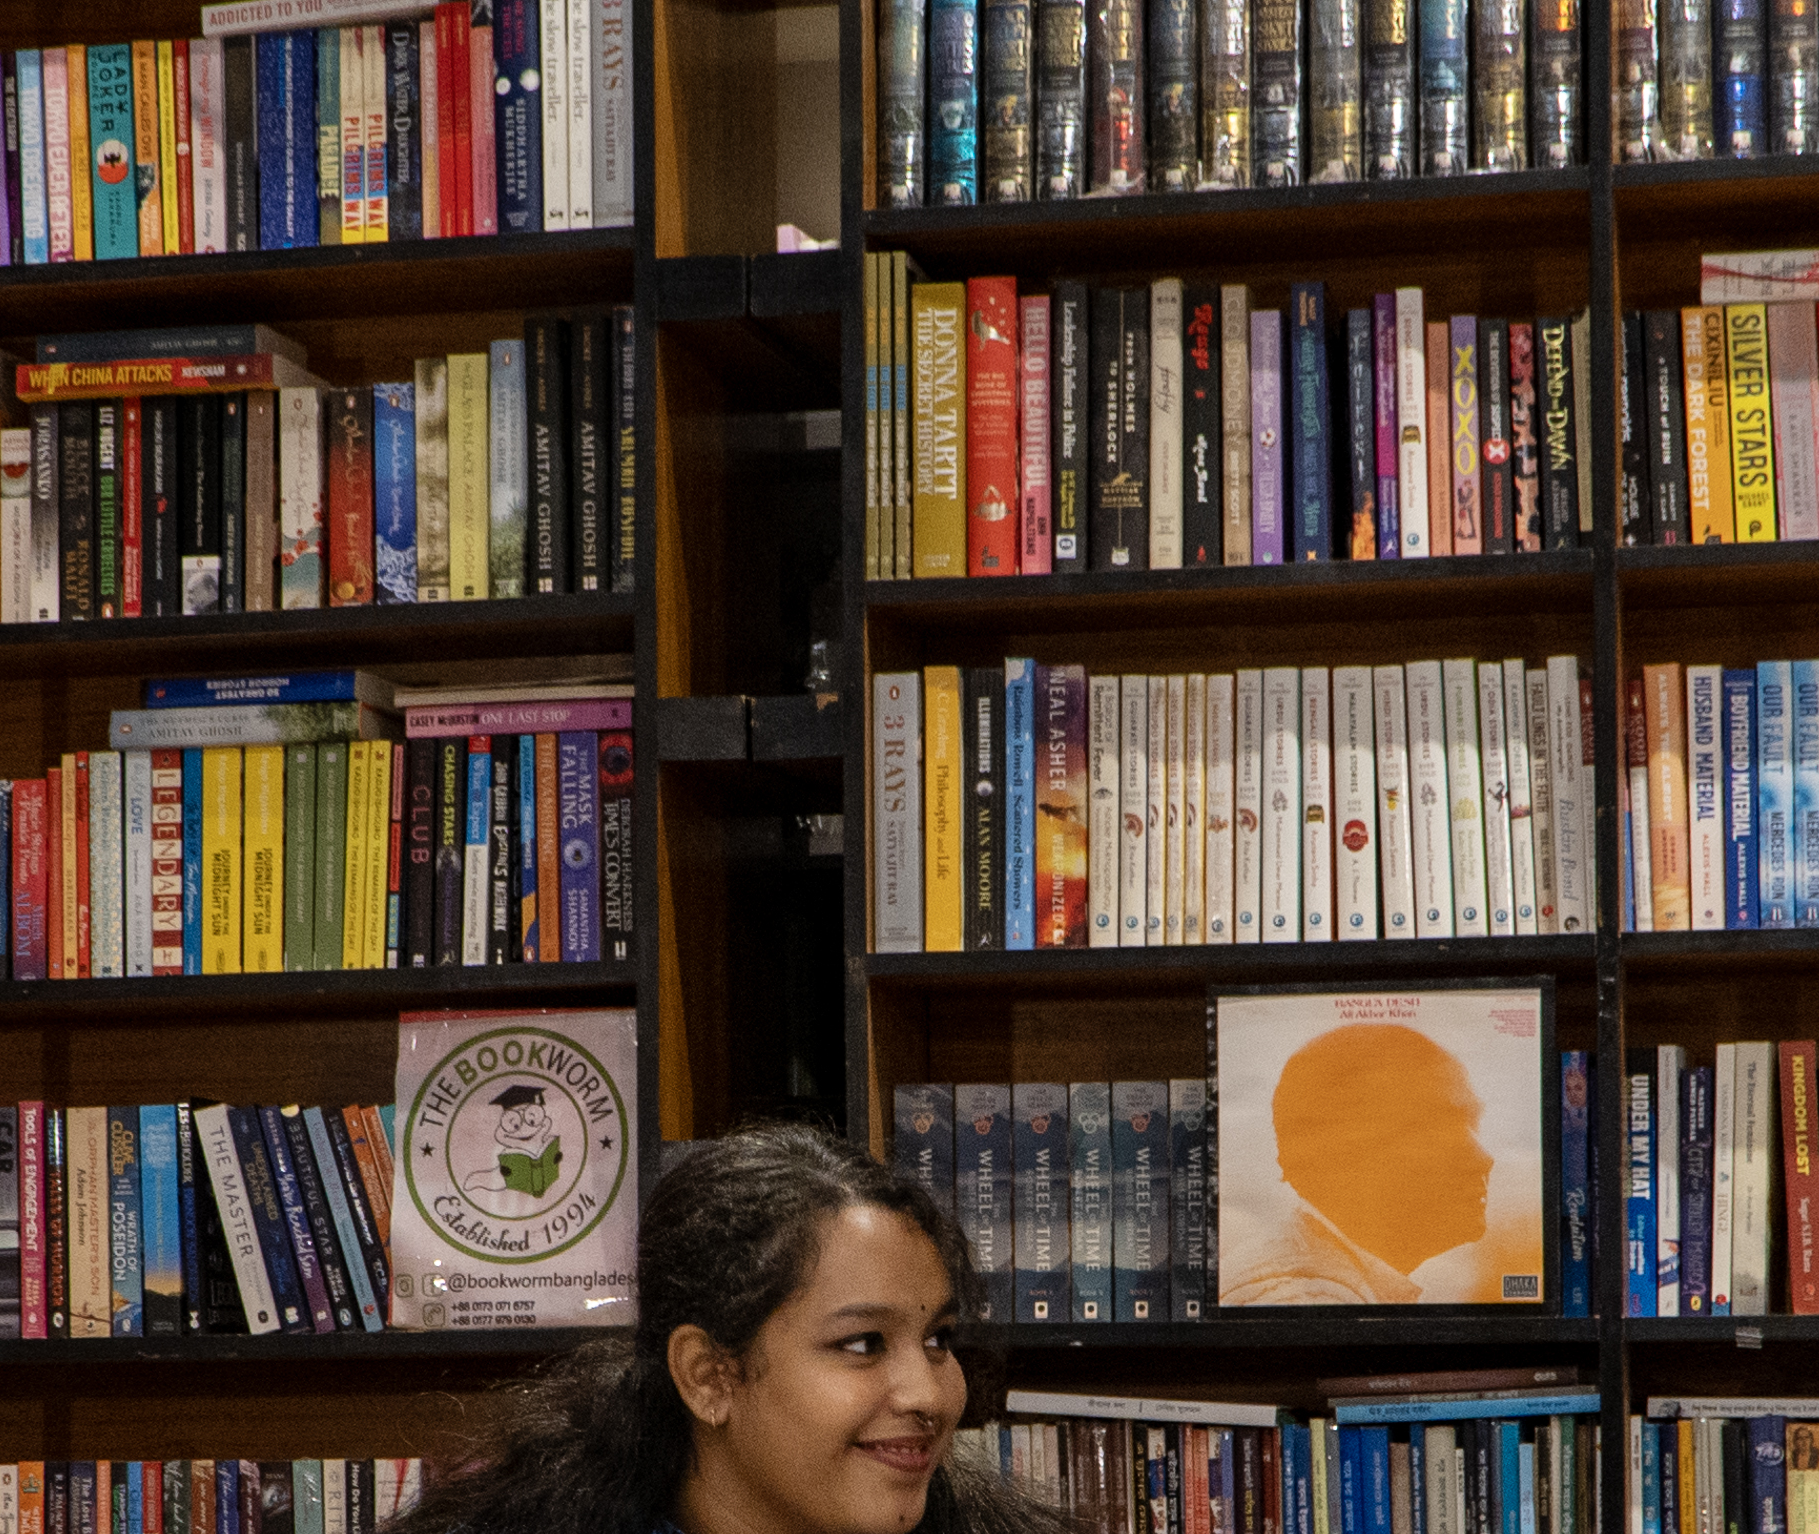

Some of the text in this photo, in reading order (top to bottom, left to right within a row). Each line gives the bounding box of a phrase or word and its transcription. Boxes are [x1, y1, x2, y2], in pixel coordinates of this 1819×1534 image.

[209, 5, 273, 27] ADDICTED
[278, 2, 292, 17] TO
[366, 113, 385, 231] PILGRIMS WAY
[29, 364, 172, 393] WHEN CHINA ATTACKS
[917, 308, 933, 496] THE SECRET HISTORY
[933, 307, 958, 500] DONNA TARTT
[1025, 307, 1047, 491] HELLO BEAUTIFUL
[1452, 344, 1477, 476] XOXO
[1732, 314, 1769, 488] SILVER STARS
[581, 421, 597, 569] AMITAV GHOSH
[1048, 671, 1067, 792] NEAL ASHER
[1693, 675, 1716, 822] HUSBAND MATERIAL
[1798, 683, 1819, 717] OUR
[1798, 720, 1819, 774] FAULT
[442, 745, 456, 846] CHASING STARS
[560, 745, 579, 830] FALLING
[1729, 695, 1752, 842] BOYFRIEND MATERIAL
[156, 771, 181, 929] LEGENDARY
[977, 807, 991, 912] ALAN MOORE
[419, 1039, 614, 1128] THE BOOKWORM
[1631, 1074, 1651, 1200] UNDER MY HAT
[1791, 1055, 1810, 1177] KINGDOM LOST
[111, 1201, 126, 1282] POSEIDON
[209, 1126, 256, 1261] THE MASTER
[433, 1191, 597, 1252] Established 1994
[1135, 1147, 1151, 1272] WHEEL TIME
